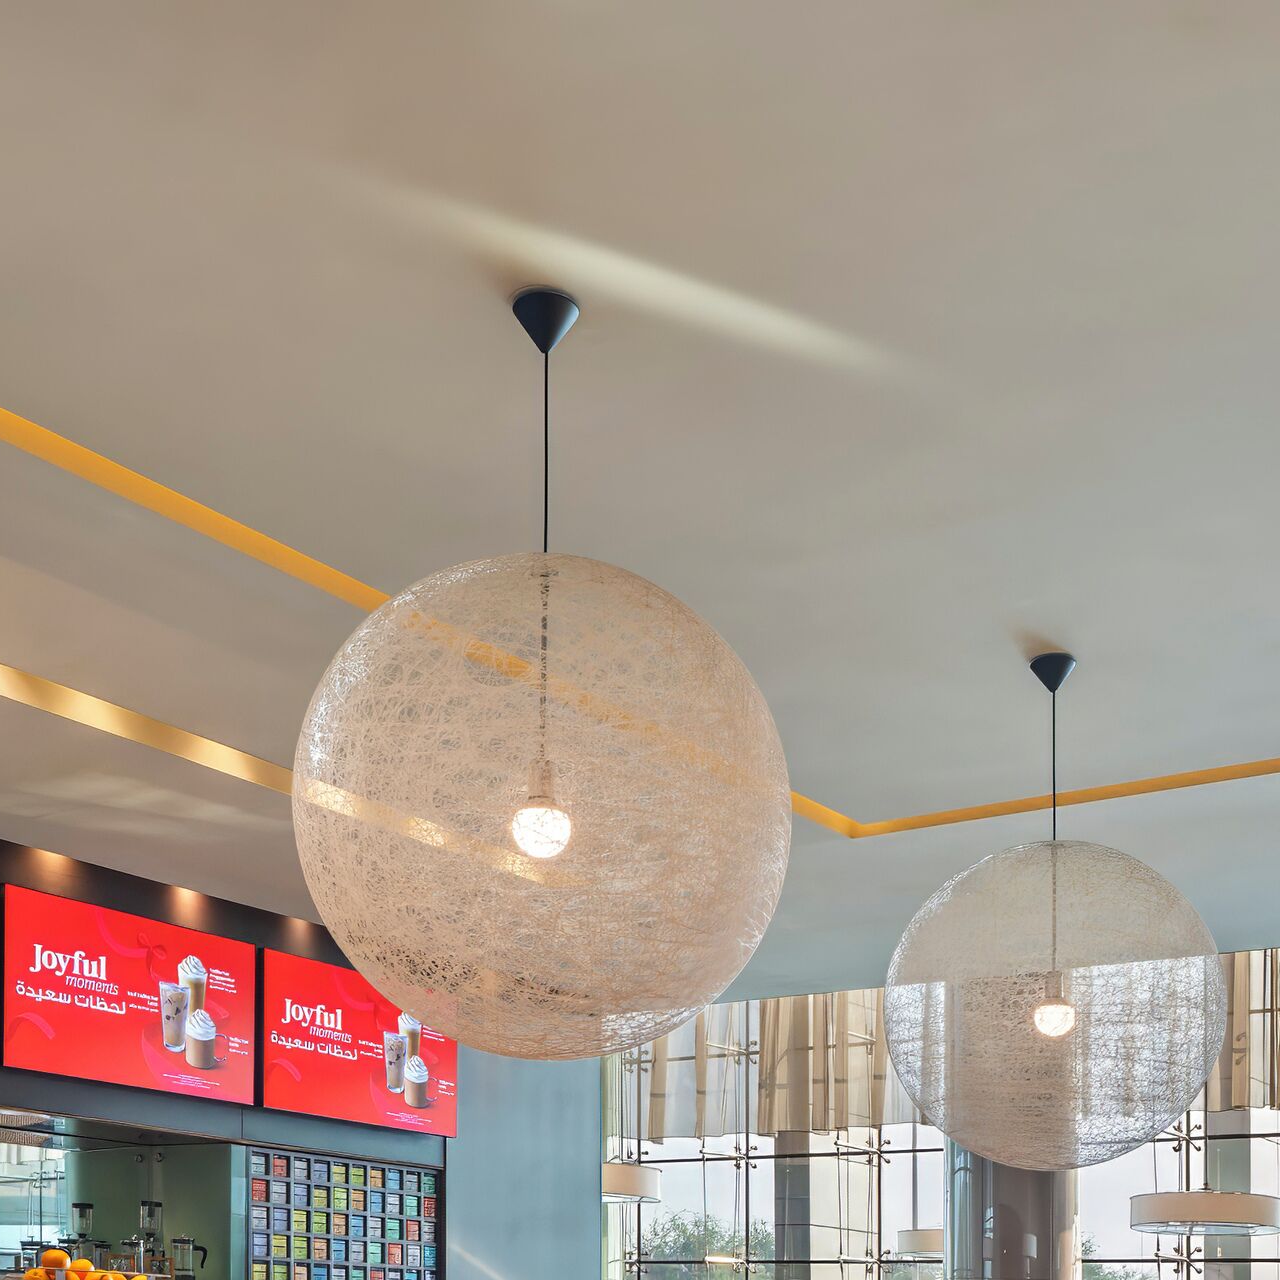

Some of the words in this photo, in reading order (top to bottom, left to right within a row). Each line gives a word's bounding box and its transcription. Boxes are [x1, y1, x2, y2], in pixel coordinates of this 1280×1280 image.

[28, 943, 107, 981] Joyful
[15, 979, 71, 1002] سعيدة
[65, 975, 119, 996] moments
[74, 994, 126, 1015] لحظات
[281, 998, 342, 1031] Joyful
[271, 1030, 315, 1051] سعيدة
[309, 1026, 352, 1044] moments
[317, 1042, 358, 1061] لحظات
